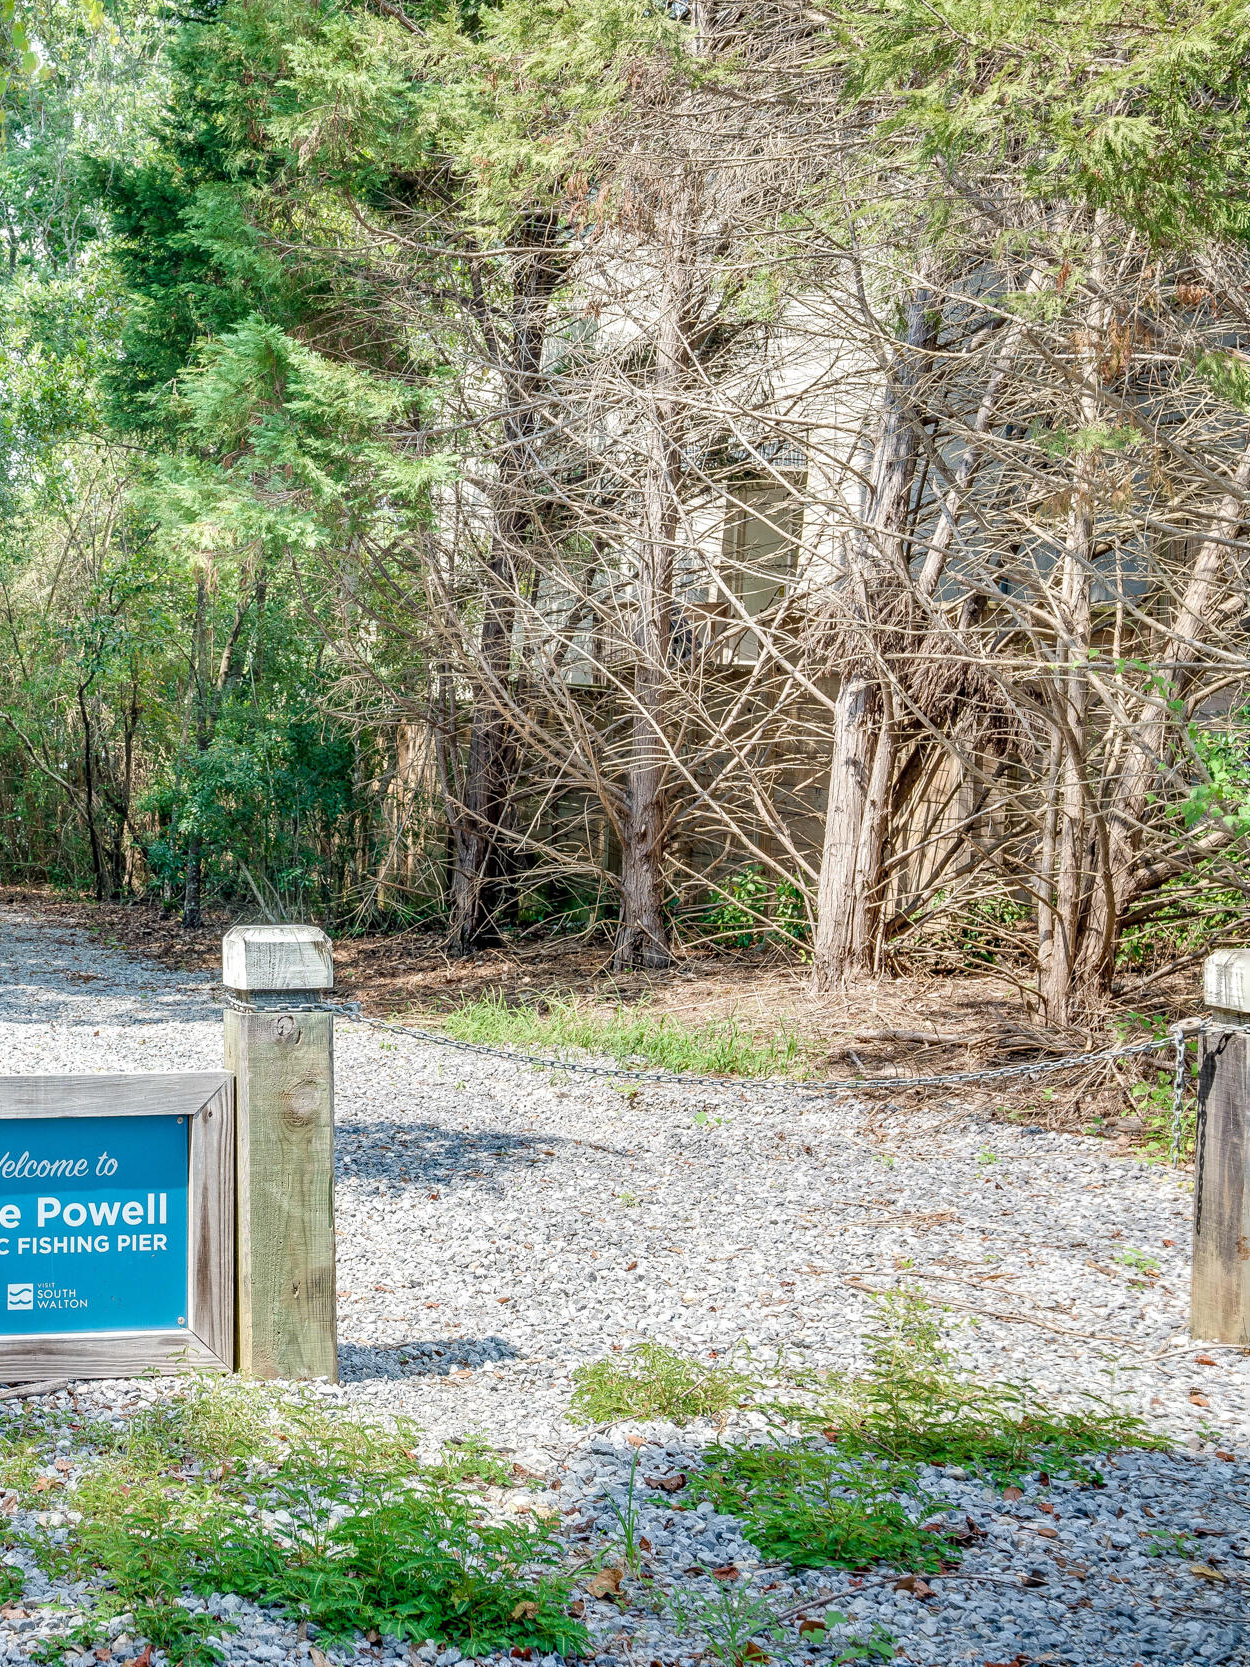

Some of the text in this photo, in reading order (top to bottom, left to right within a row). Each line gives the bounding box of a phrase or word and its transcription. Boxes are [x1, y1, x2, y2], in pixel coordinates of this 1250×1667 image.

[95, 1151, 119, 1177] to
[37, 1192, 168, 1228] Powell
[17, 1235, 110, 1255] FISHING
[117, 1233, 168, 1252] PIER
[37, 1288, 77, 1299] SOUTH
[37, 1298, 88, 1309] WALTON
